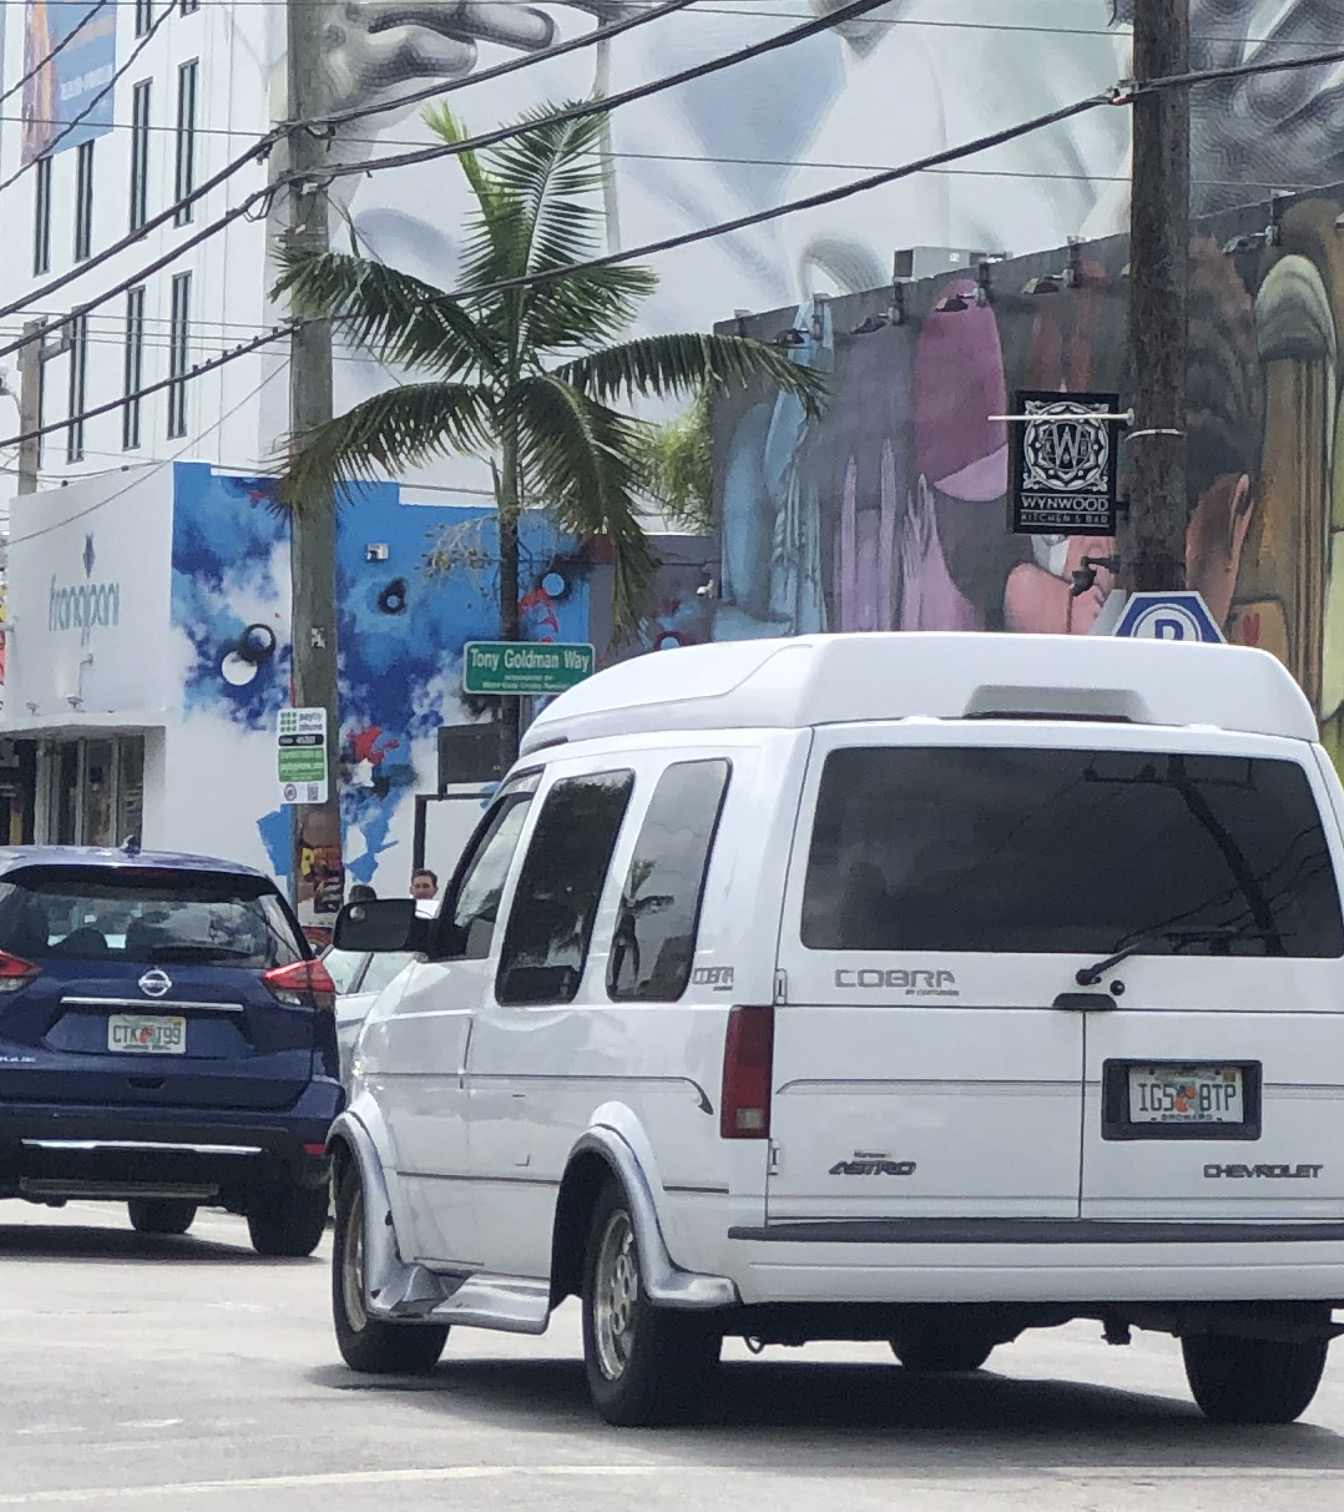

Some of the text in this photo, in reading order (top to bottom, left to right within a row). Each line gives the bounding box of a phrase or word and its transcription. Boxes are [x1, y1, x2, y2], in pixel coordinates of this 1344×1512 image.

[1021, 496, 1109, 511] WYNWOOD
[470, 648, 590, 673] Tony Goldman Way
[835, 969, 956, 989] COBRA
[828, 1160, 917, 1175] ASTRO
[1203, 1164, 1324, 1178] CHEVROLET
